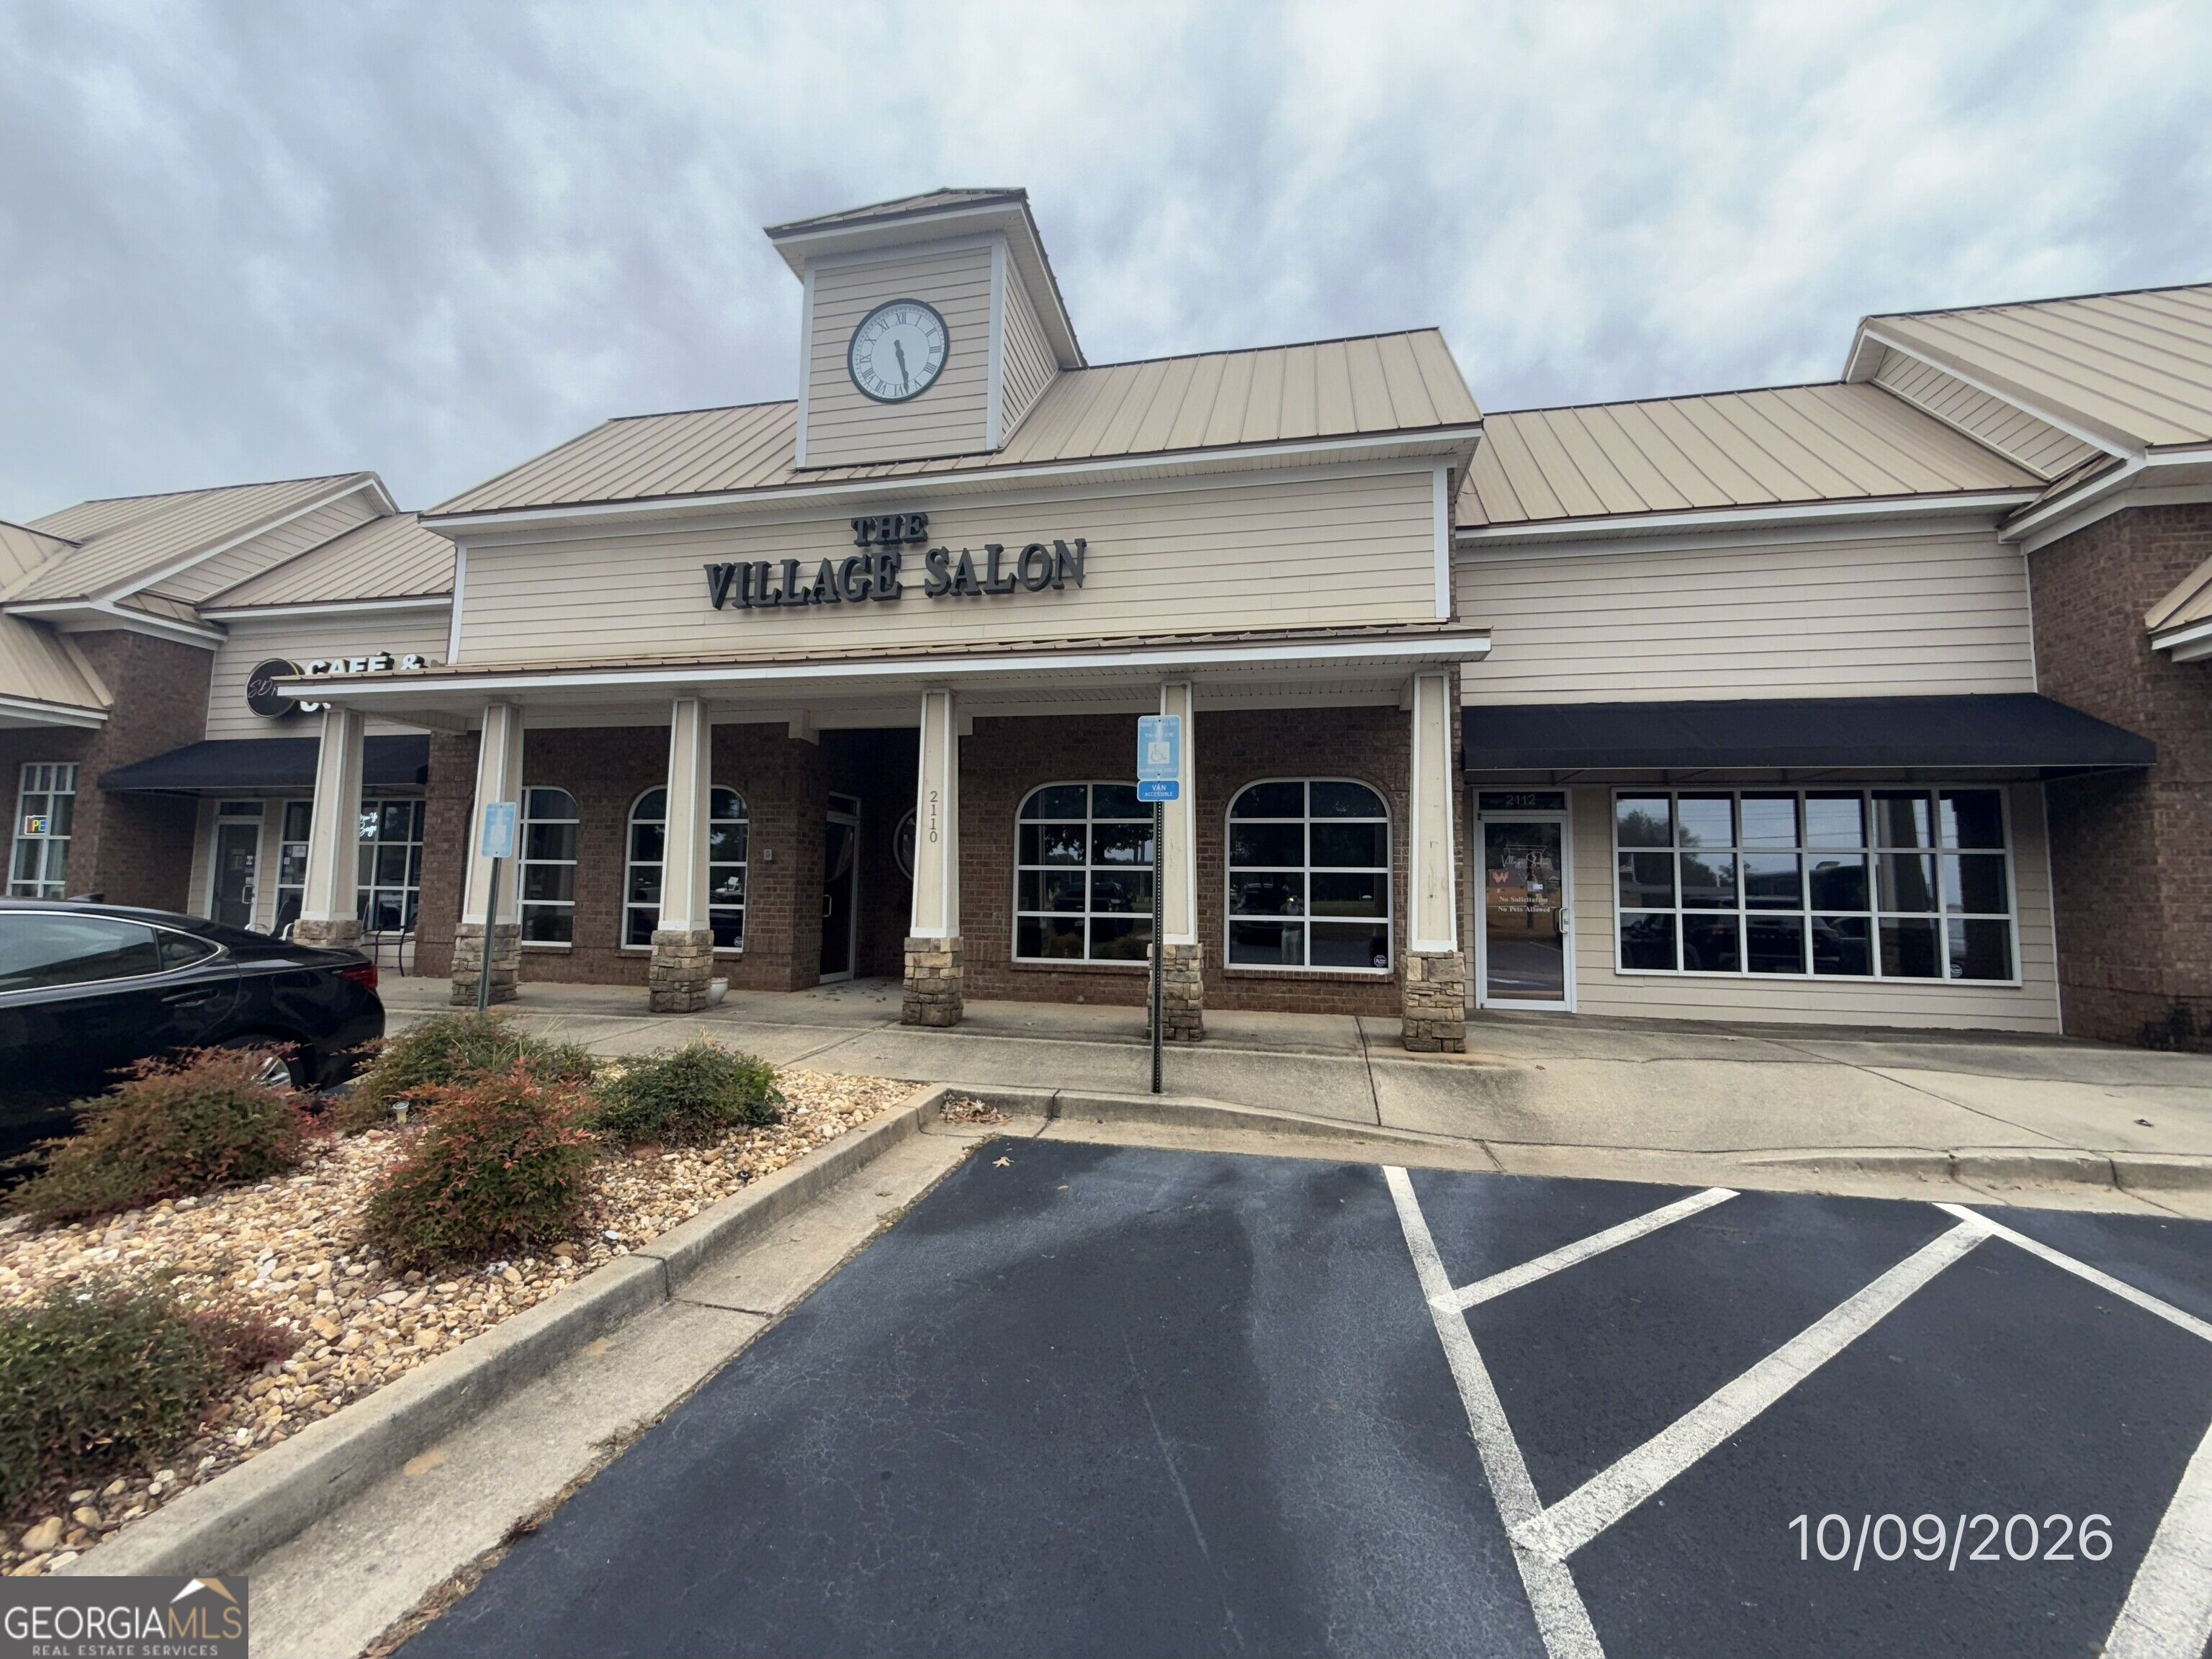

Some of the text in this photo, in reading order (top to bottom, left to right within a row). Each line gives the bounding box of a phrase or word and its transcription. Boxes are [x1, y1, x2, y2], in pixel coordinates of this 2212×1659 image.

[850, 512, 930, 548] THE
[703, 538, 1088, 611] VILLAGE SALON
[401, 653, 423, 670] &
[930, 791, 938, 842] 2110
[1506, 794, 1536, 805] 2112
